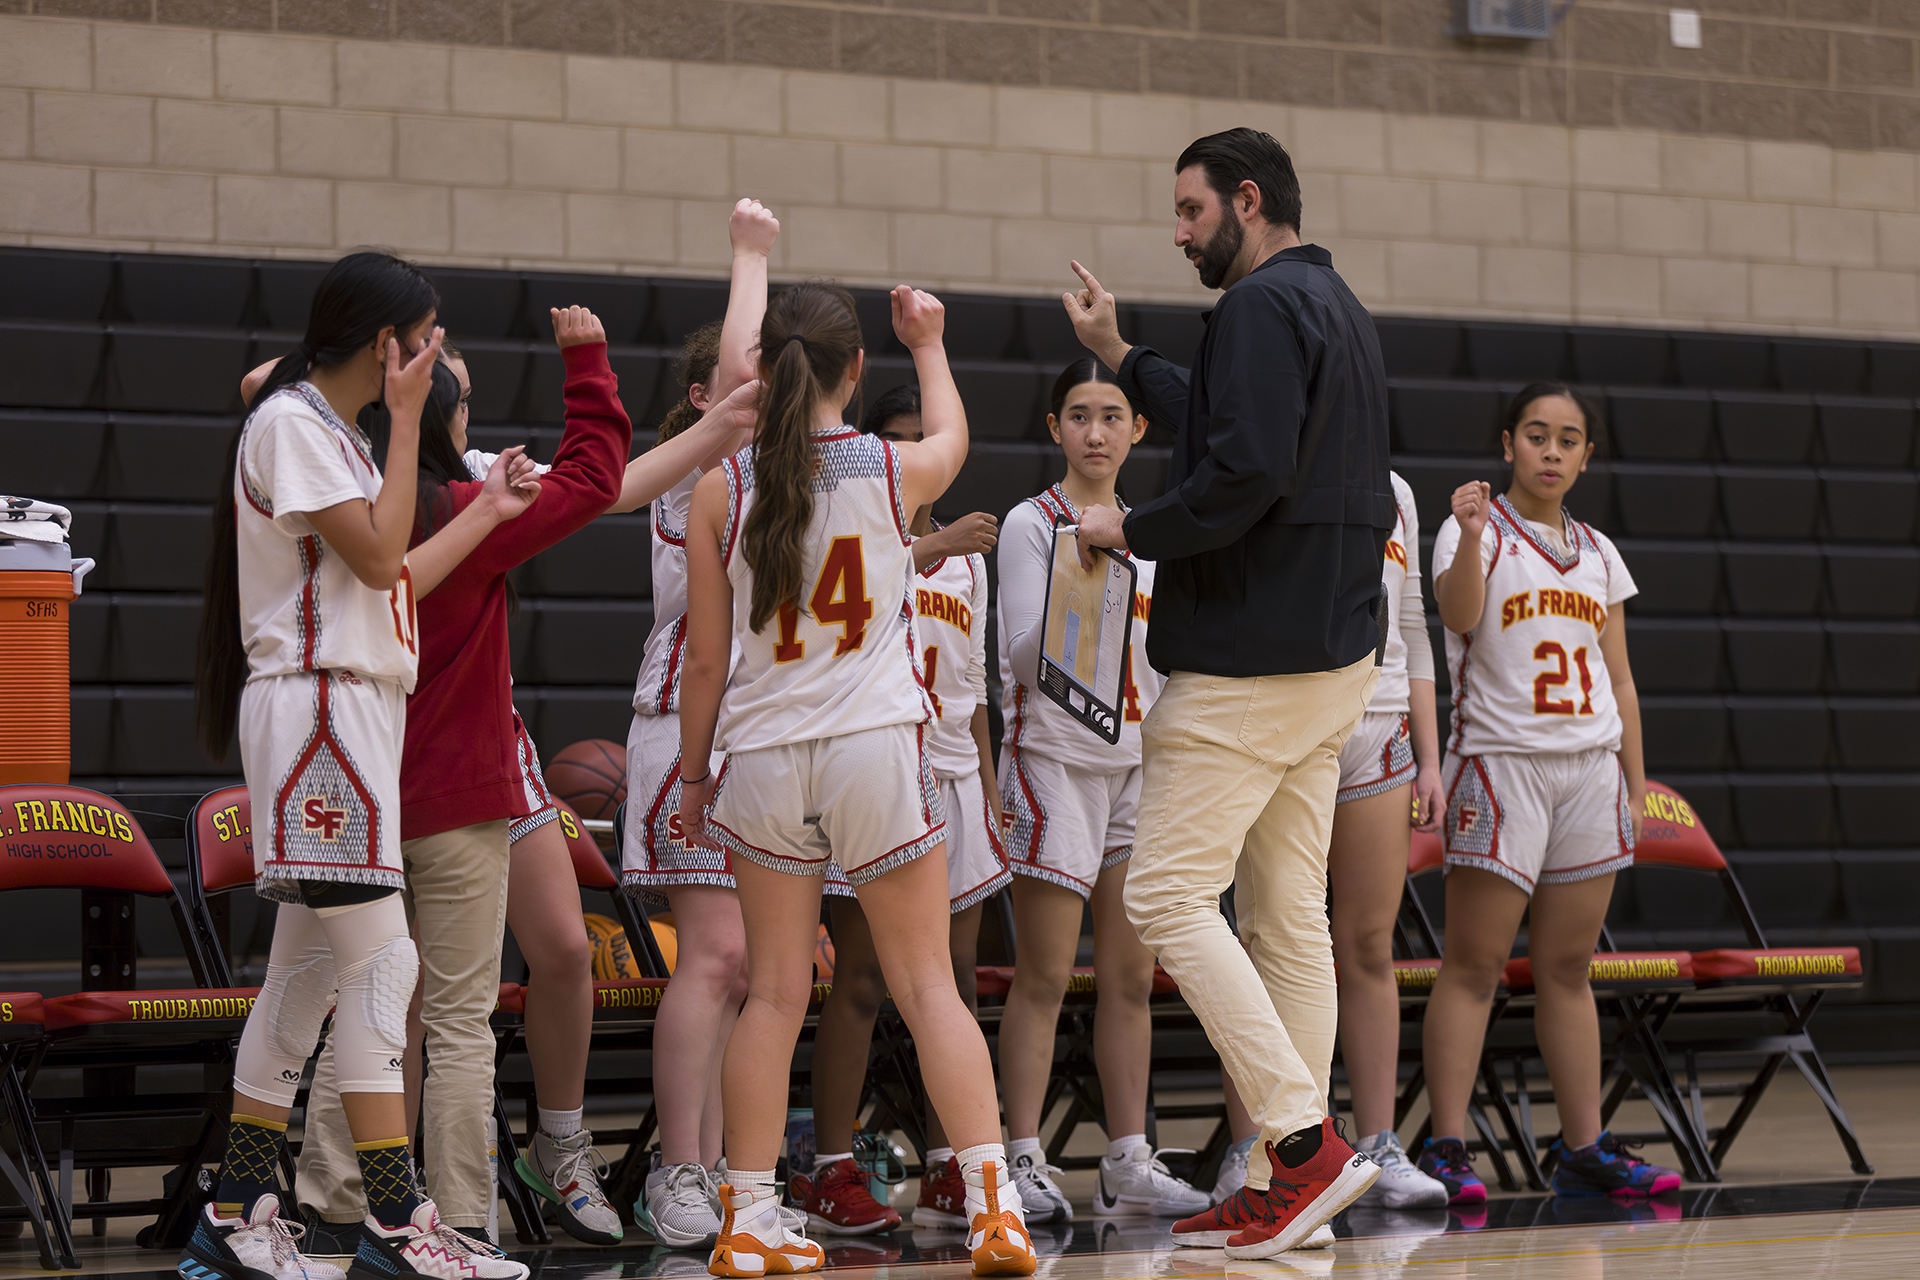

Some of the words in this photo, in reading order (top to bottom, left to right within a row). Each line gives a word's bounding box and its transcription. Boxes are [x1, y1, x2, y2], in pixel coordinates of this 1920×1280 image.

[26, 601, 58, 618] SFHS
[773, 534, 874, 665] 14
[915, 587, 973, 639] RANC
[1501, 589, 1535, 632] ST.
[1533, 639, 1595, 717] 21
[13, 799, 135, 844] FRANCIS
[211, 801, 252, 843] ST.
[301, 794, 348, 843] SF
[1643, 790, 1695, 829] NCIS
[6, 843, 42, 859] HIGH
[46, 843, 113, 859] SCHOOL
[1754, 954, 1846, 976] TROUBADOURS
[598, 986, 669, 1008] TROUBA
